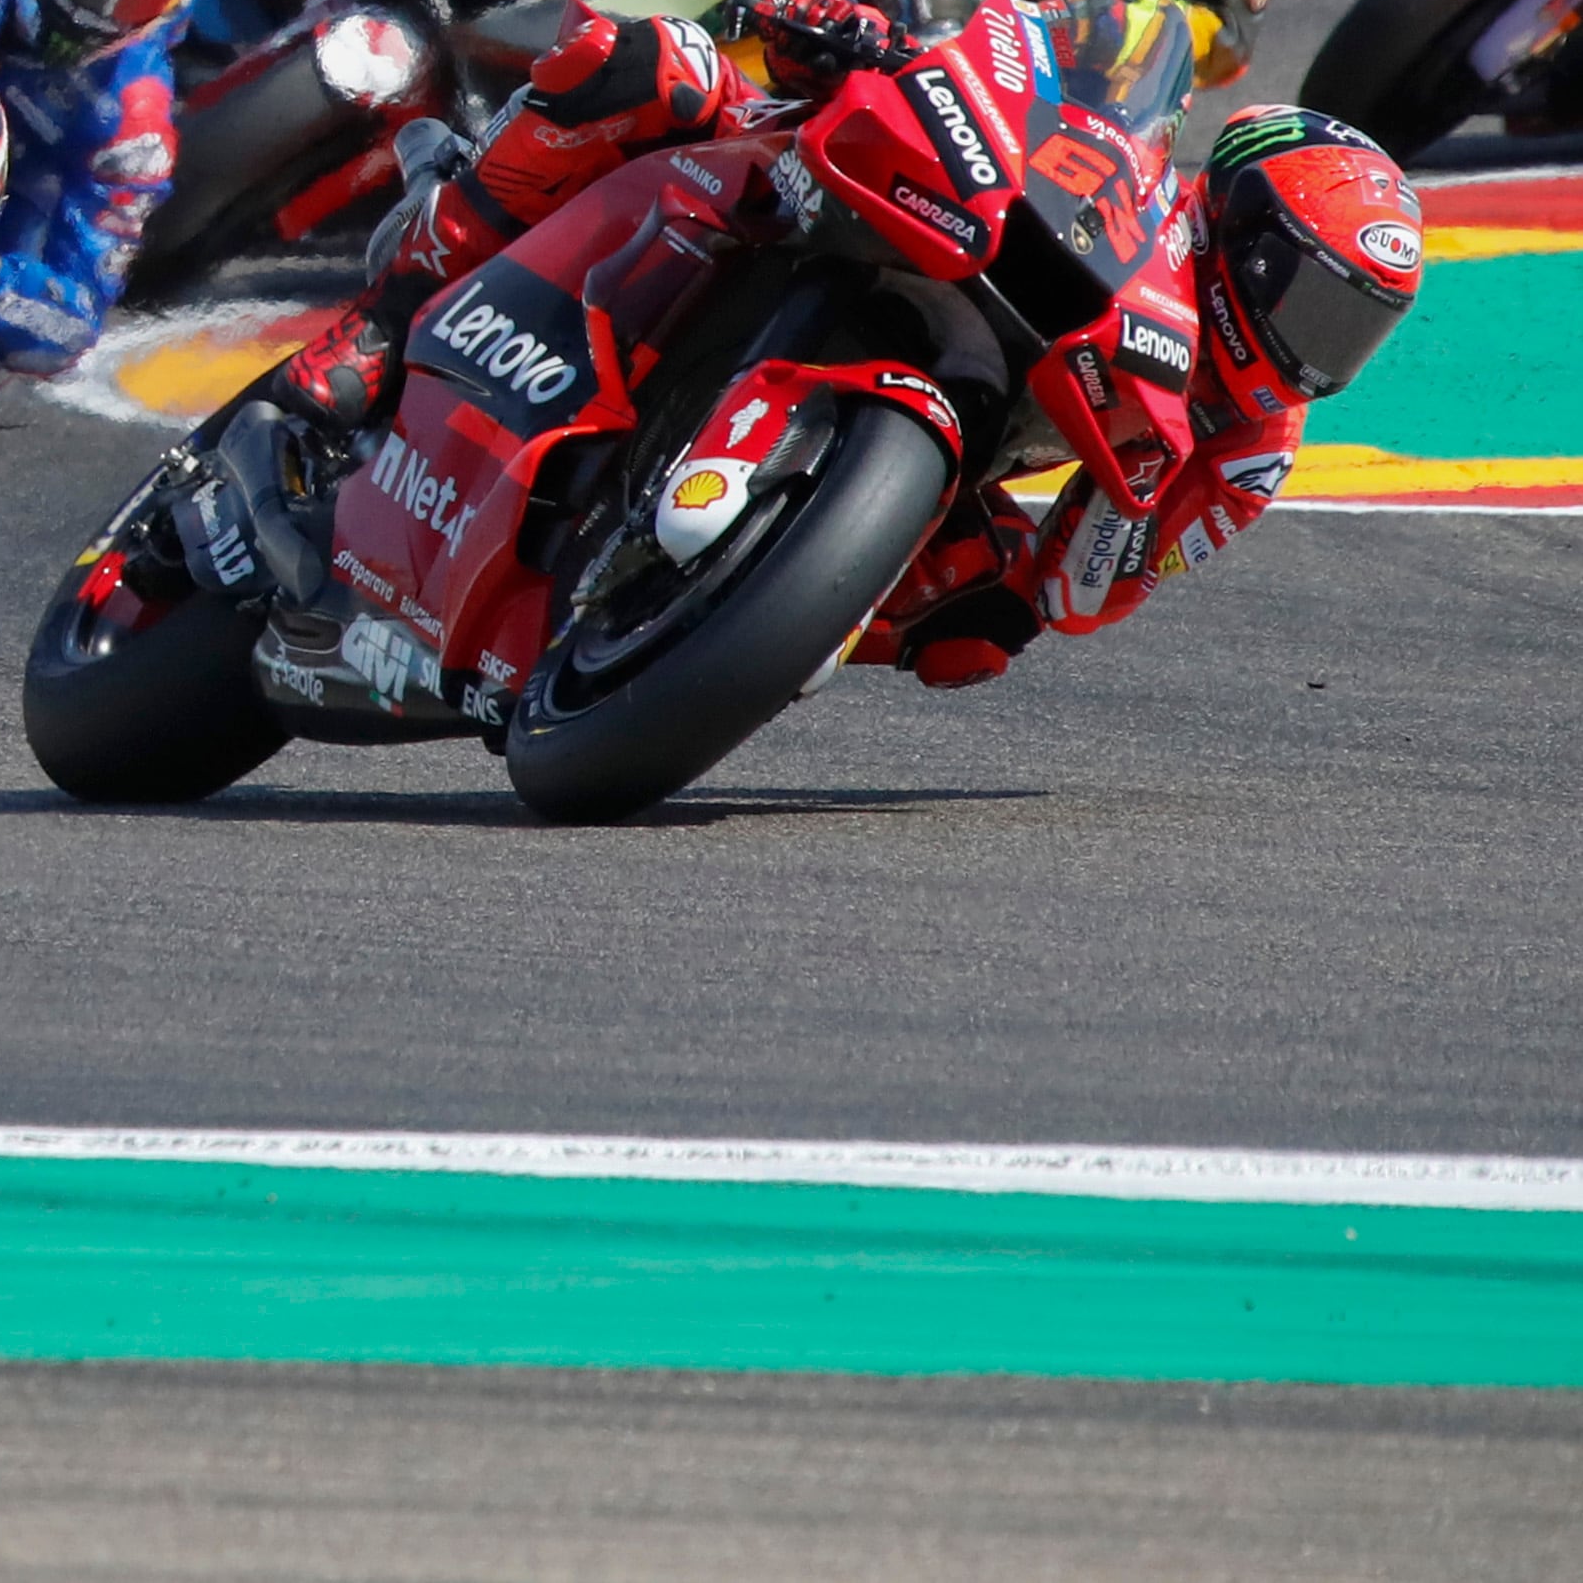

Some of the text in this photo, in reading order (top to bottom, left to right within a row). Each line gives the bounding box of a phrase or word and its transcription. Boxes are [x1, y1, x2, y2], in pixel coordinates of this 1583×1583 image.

[914, 68, 999, 187] Lenovo
[1085, 115, 1148, 197] VARGROUP
[682, 156, 724, 196] DAIKO
[1026, 130, 1147, 266] 63
[894, 185, 977, 244] CARRERA
[431, 280, 577, 405] Lenovo
[1122, 313, 1190, 373] Lenovo
[1209, 280, 1248, 363] Lenovo
[1076, 348, 1108, 408] CARRERA
[1079, 507, 1123, 589] nipolSai
[1123, 513, 1148, 574] novo
[332, 548, 394, 604] streparava
[477, 648, 518, 683] SKF
